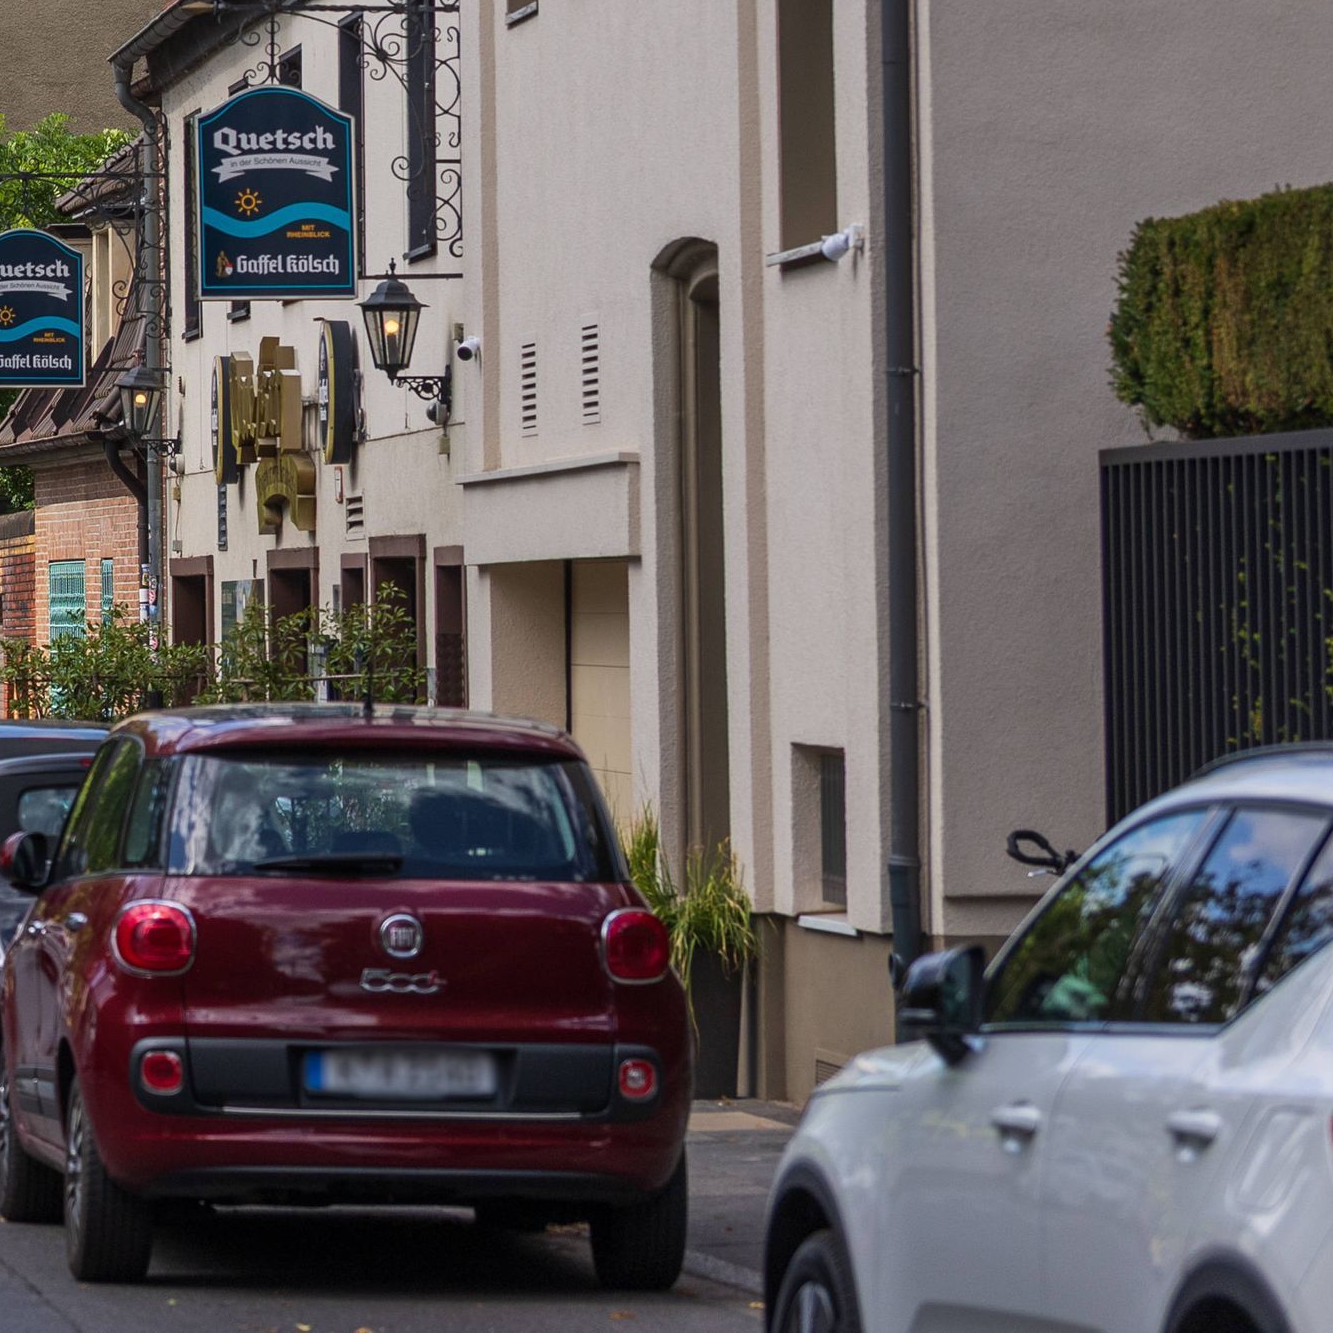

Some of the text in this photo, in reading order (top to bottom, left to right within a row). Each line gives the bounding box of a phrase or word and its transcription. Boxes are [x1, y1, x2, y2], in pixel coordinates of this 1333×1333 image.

[213, 125, 336, 156] Quetsch
[230, 157, 322, 168] in der Schönen Aussicht
[286, 231, 331, 239] RHEINBLICK
[236, 254, 340, 275] Gaffel Kölsch
[33, 354, 72, 370] Kölsch
